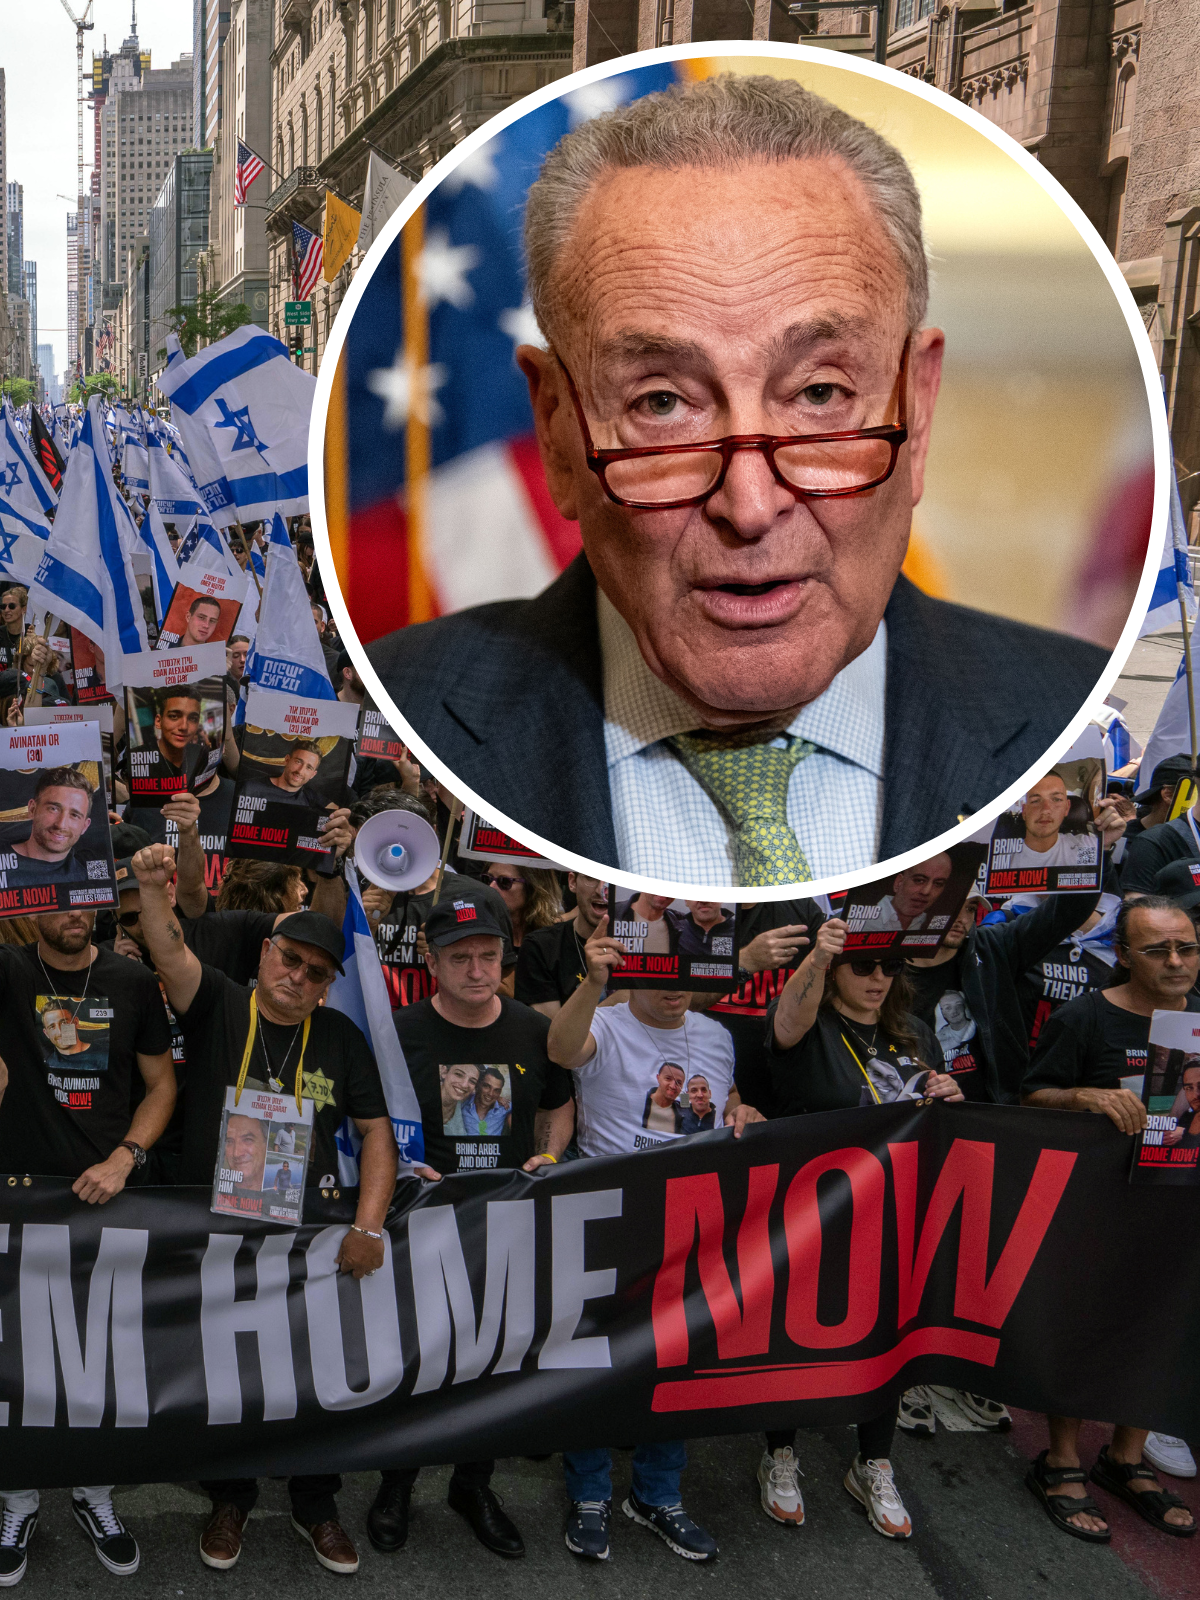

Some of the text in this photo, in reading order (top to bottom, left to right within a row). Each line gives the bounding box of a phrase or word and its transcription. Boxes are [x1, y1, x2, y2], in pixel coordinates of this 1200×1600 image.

[160, 630, 180, 644] BRING
[75, 667, 93, 678] BRING
[153, 664, 198, 677] EDAN ALEXANDER
[284, 715, 319, 726] AVINATAN OR
[363, 724, 380, 738] HIM
[9, 733, 60, 749] AVINATAN OR
[360, 738, 385, 753] HOME
[130, 751, 160, 765] BRING
[131, 765, 149, 777] HIM
[132, 773, 187, 791] HOME NOW!
[237, 796, 267, 811] BRING
[235, 810, 254, 824] HIM
[233, 825, 289, 843] HOME NOW!
[476, 830, 506, 847] HOME
[993, 838, 1024, 854] BRING
[992, 854, 1010, 870] HIM
[990, 868, 1047, 888] HOME NOW!
[1058, 877, 1096, 887] FAMILIES FORUM
[23, 885, 57, 906] NOW!
[70, 893, 113, 904] FAMILIES FORUM
[456, 908, 476, 920] NOW
[849, 904, 882, 919] BRING
[613, 920, 648, 938] BRING
[615, 937, 644, 953] THEM
[690, 968, 733, 977] FAMILIES FORUM
[1042, 963, 1088, 983] BRING
[1042, 978, 1085, 1000] THEM
[1146, 1115, 1178, 1131] BRING
[1143, 1131, 1164, 1145] HIM
[456, 1143, 500, 1156] BRING ARBEL
[1140, 1147, 1199, 1162] HOME NOW!
[459, 1155, 498, 1168] AND DOLEV
[220, 1168, 243, 1182] BRING
[218, 1180, 234, 1194] HIM
[217, 1194, 262, 1211] HOME NOW!
[200, 1187, 623, 1427] HOME
[651, 1139, 1078, 1369] NOW
